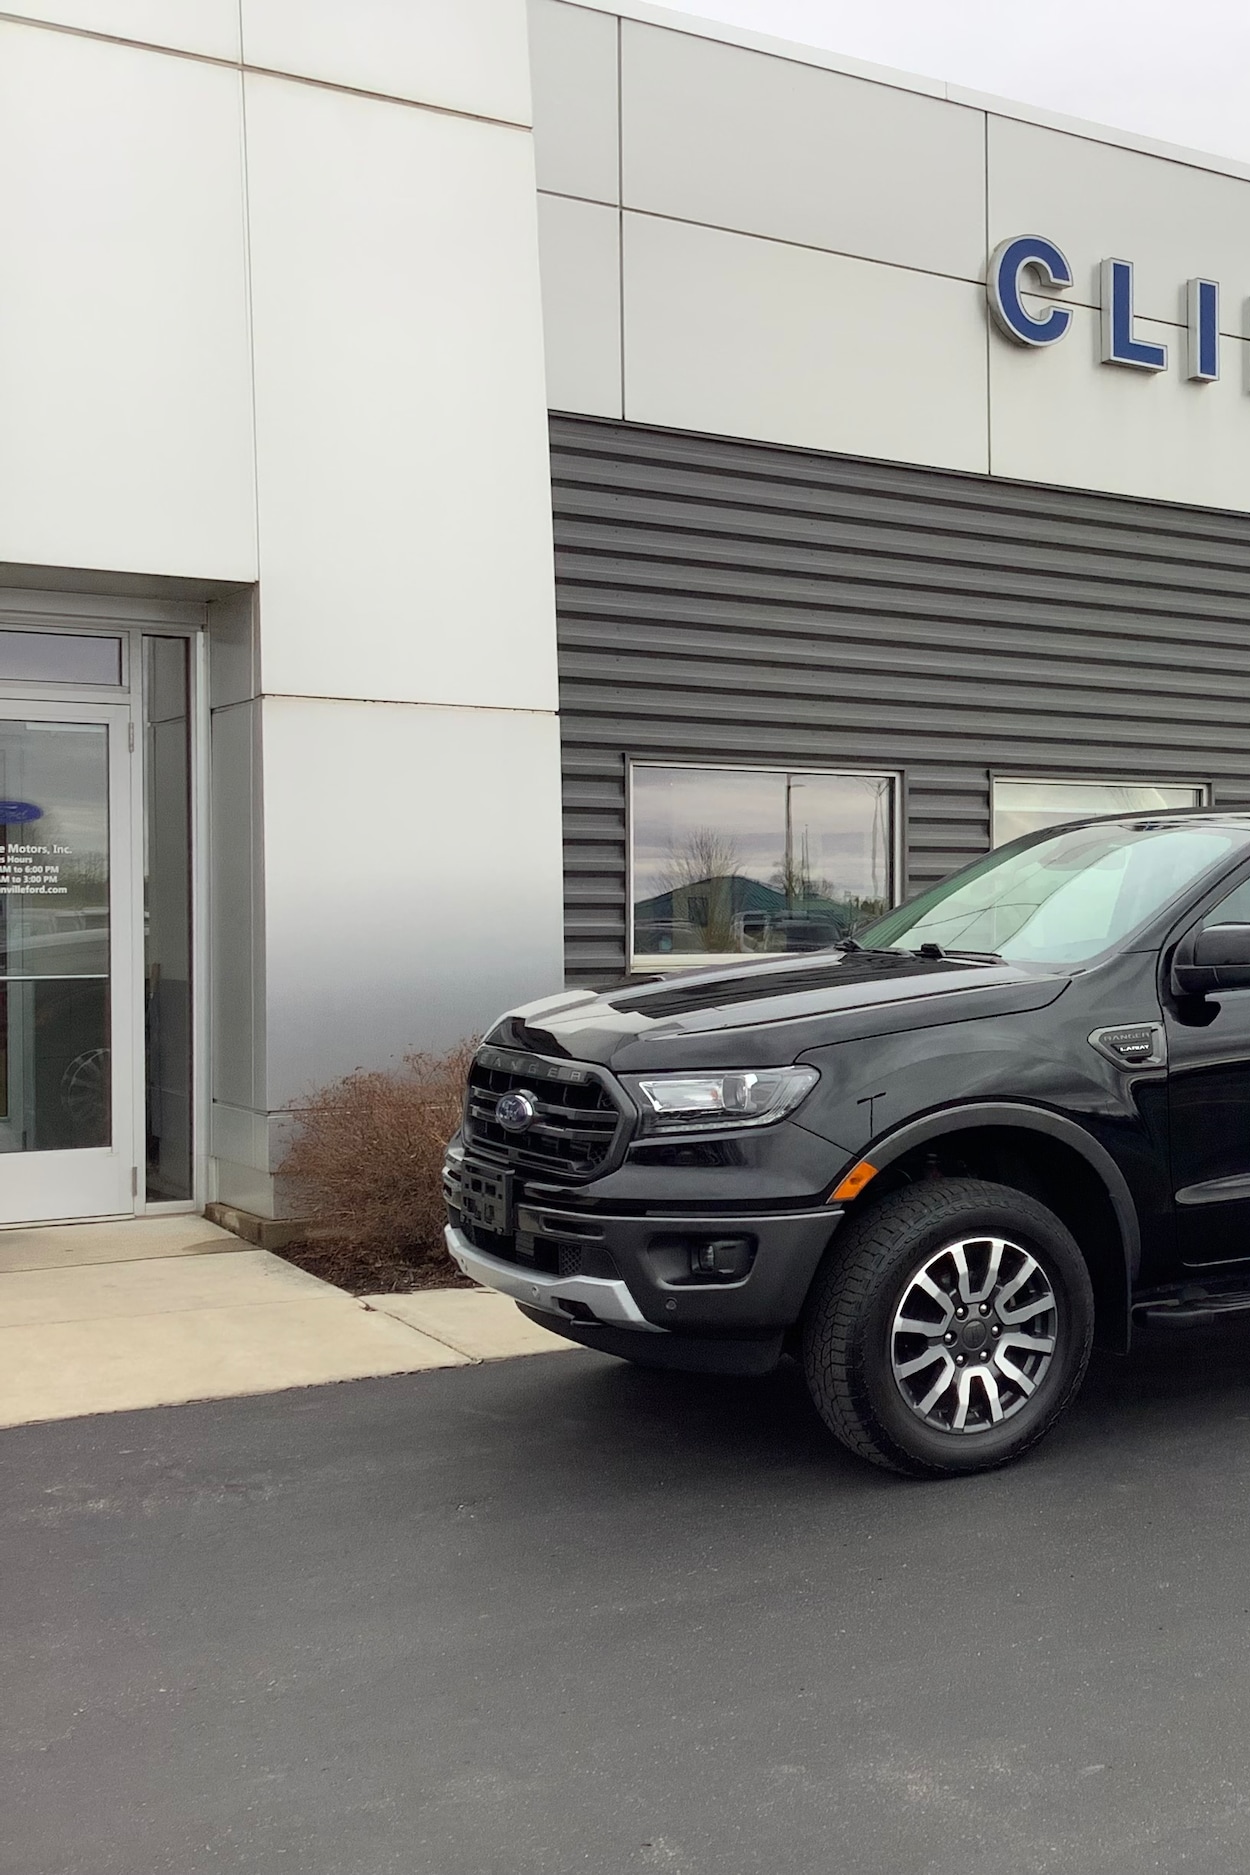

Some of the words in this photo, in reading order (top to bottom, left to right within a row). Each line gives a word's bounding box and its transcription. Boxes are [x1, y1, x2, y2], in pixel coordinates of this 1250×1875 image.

[8, 844, 50, 855] Motors,
[53, 844, 72, 854] Inc.
[7, 855, 33, 863] Hours
[23, 875, 42, 883] 3:00
[43, 875, 58, 883] PM
[1103, 1032, 1150, 1041] RANGER
[1119, 1044, 1150, 1052] LARIAT
